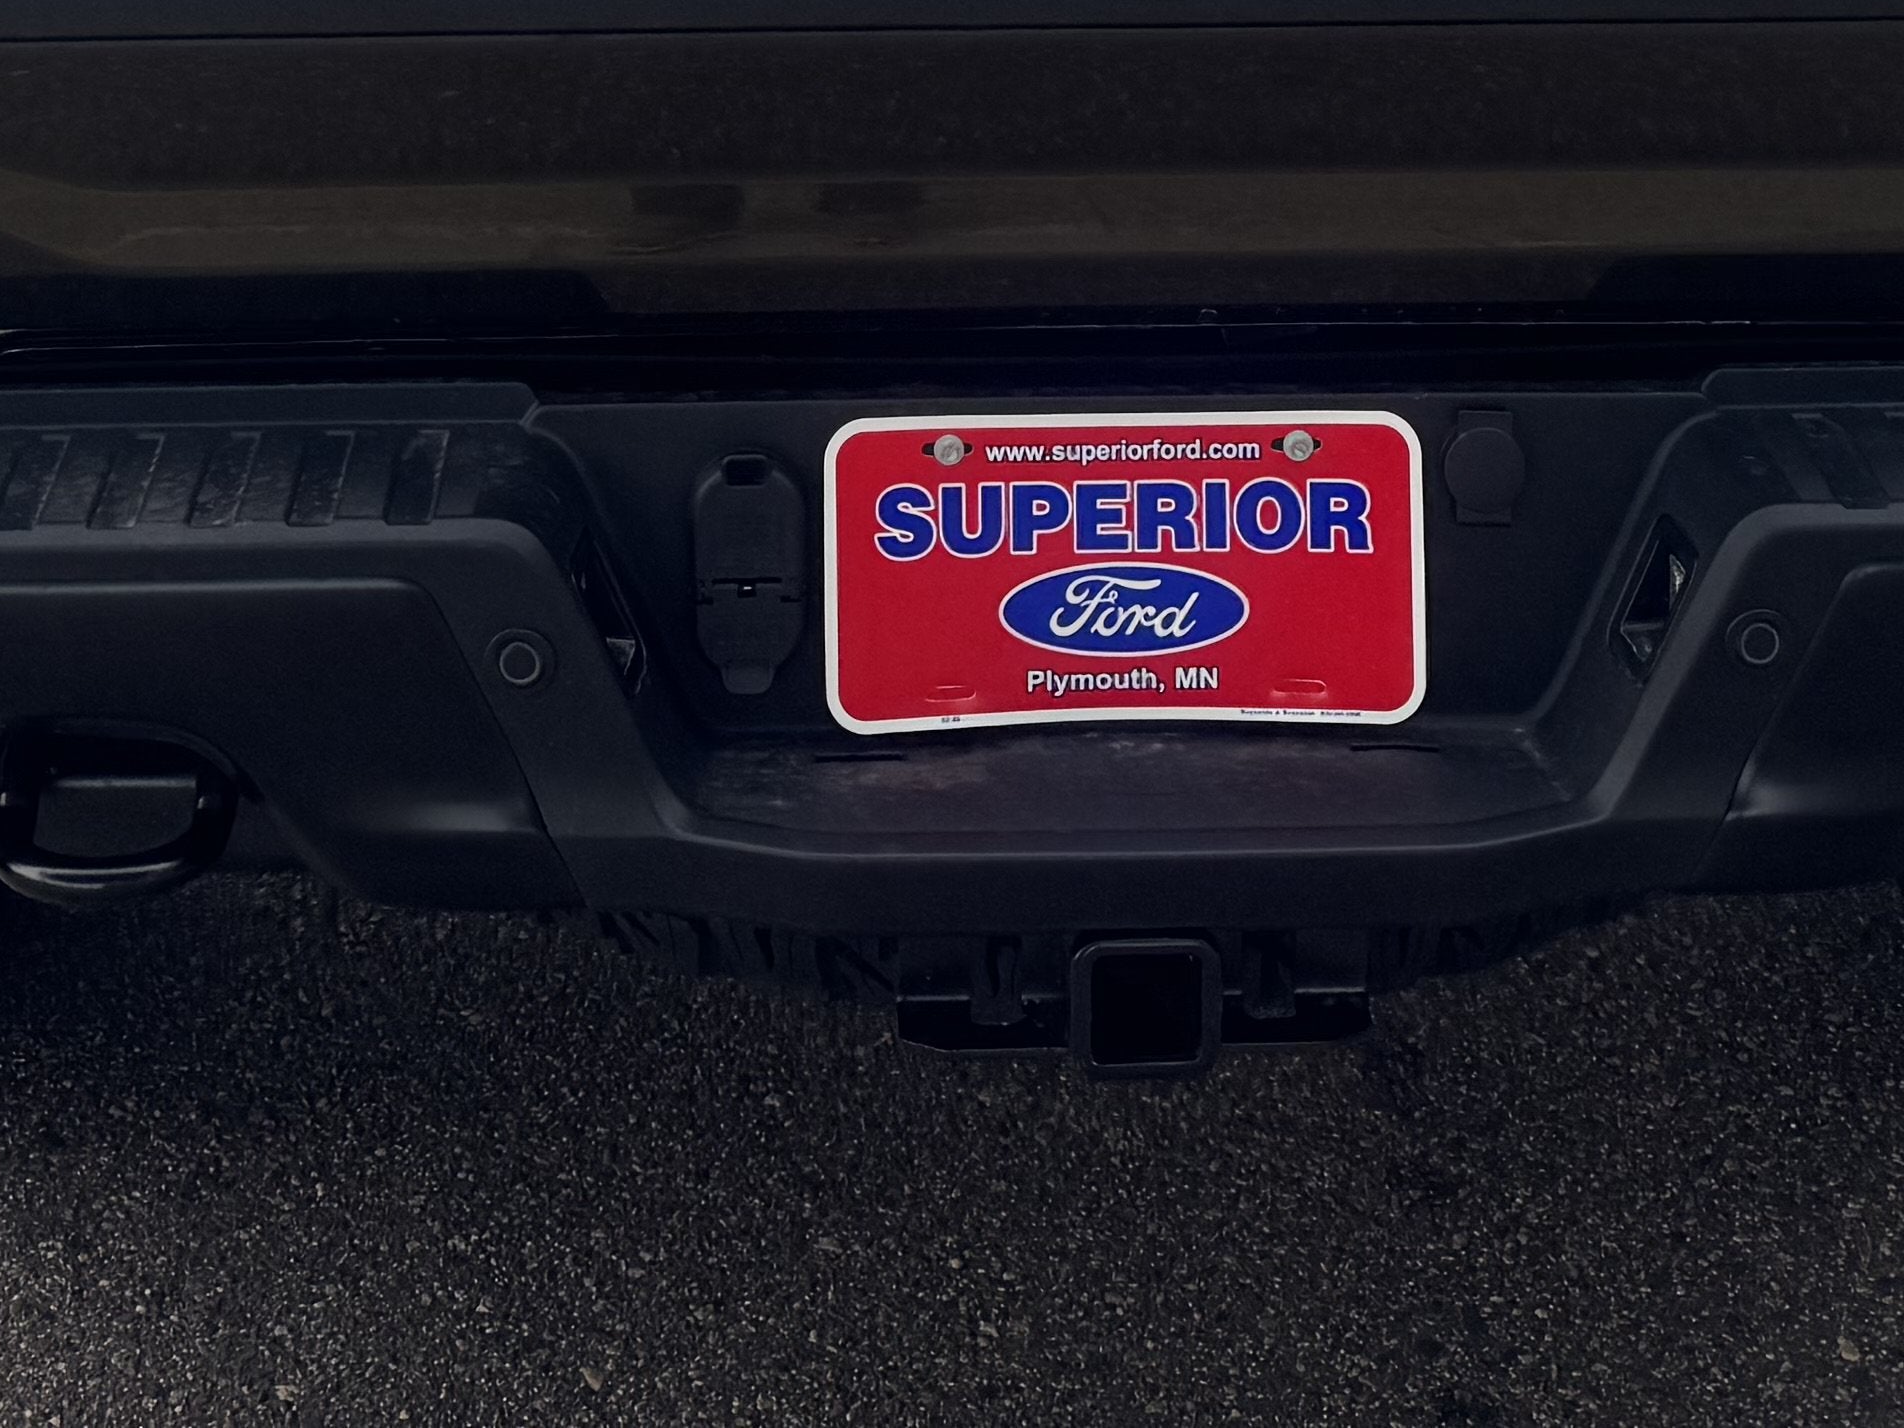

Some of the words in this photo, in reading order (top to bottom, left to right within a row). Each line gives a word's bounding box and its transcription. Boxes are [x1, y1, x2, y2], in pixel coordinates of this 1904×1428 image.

[985, 439, 1261, 466] www.superiorford.com
[874, 477, 1374, 561] SUPERIOR
[1049, 575, 1200, 638] Ford
[1026, 667, 1166, 697] Plymouth,
[1175, 666, 1219, 689] MN
